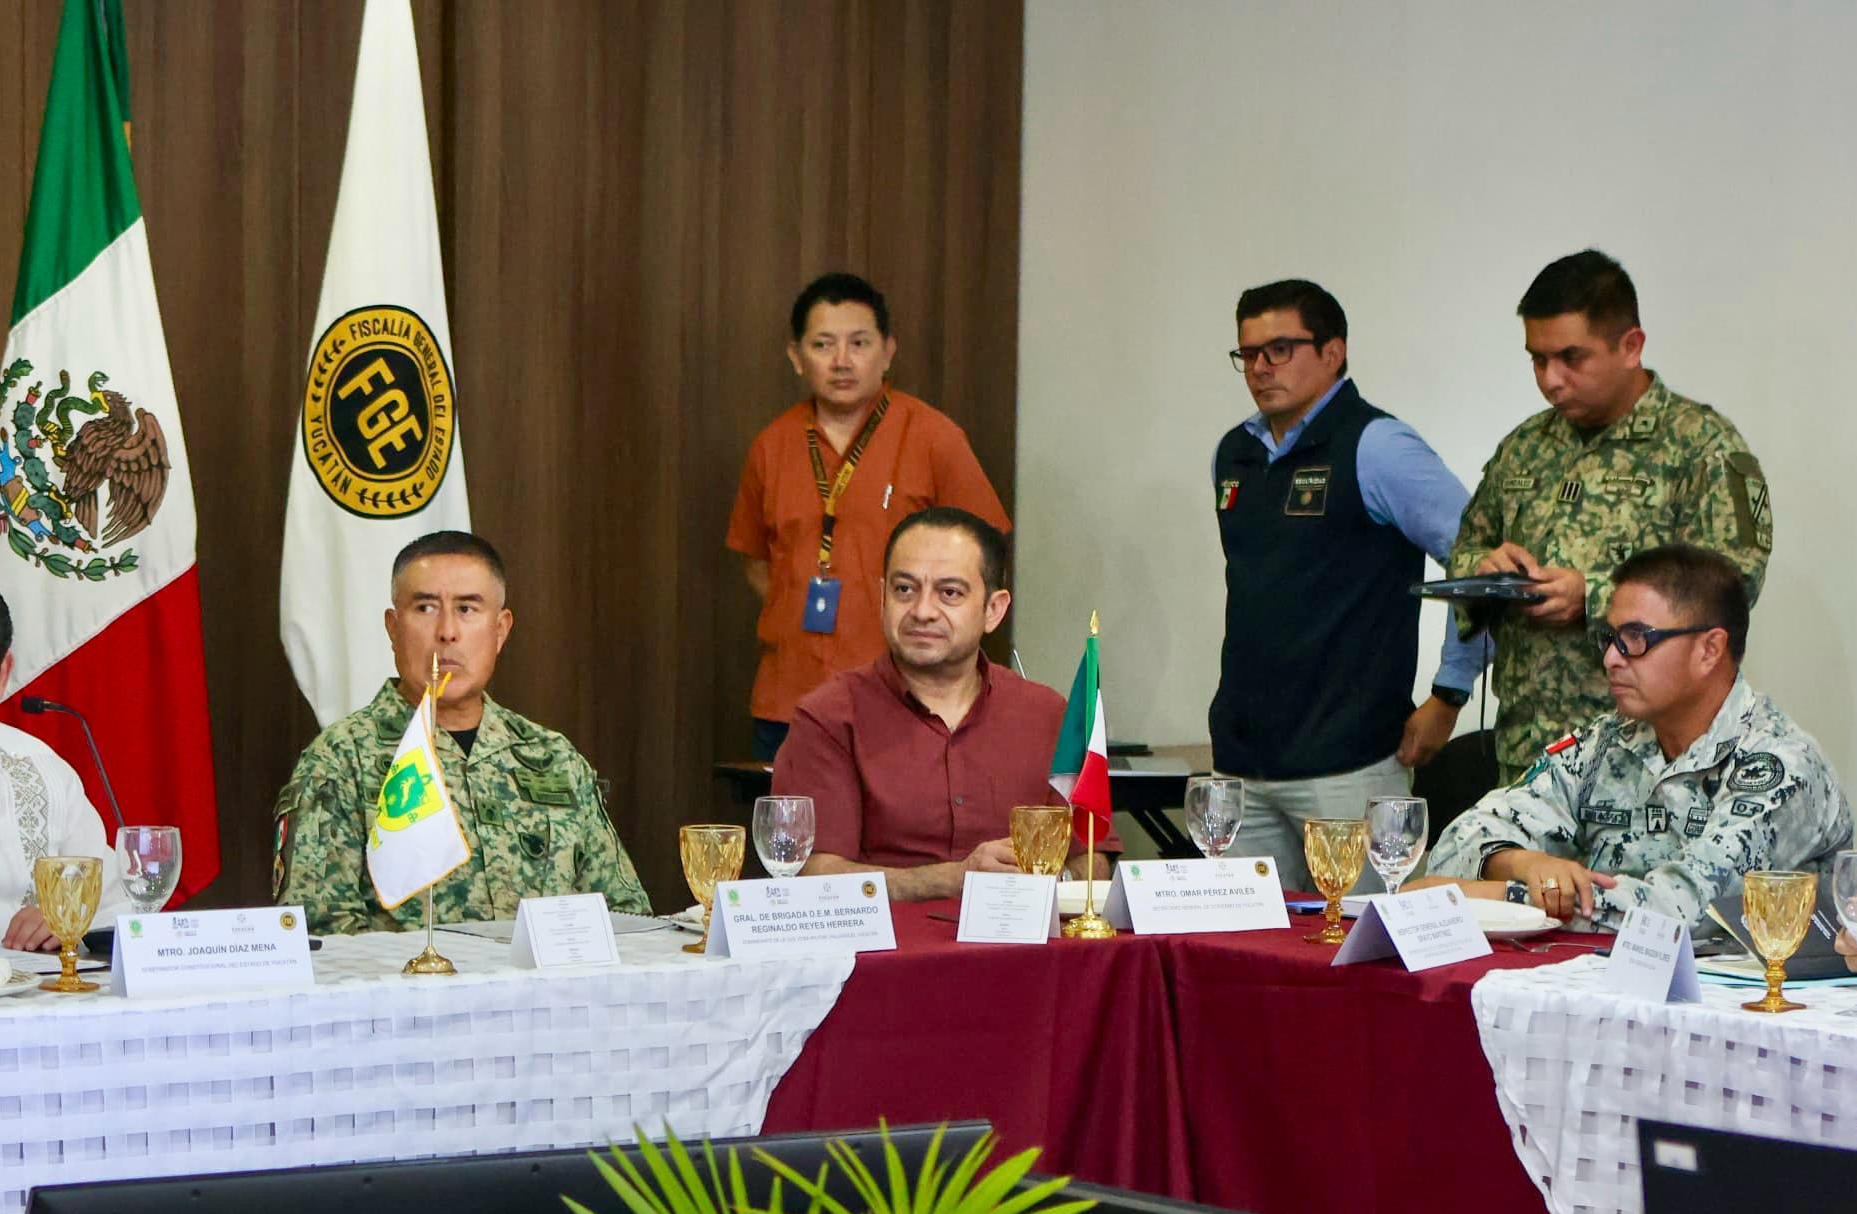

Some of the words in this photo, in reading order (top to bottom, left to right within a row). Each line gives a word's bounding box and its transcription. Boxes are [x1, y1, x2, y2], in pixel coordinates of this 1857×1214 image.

[349, 317, 412, 341] FISCALÍA
[413, 331, 443, 389] GENERAL
[337, 356, 424, 470] FGE
[432, 394, 447, 421] DEL
[310, 415, 352, 496] YUCATÁN
[426, 426, 447, 482] ESTADO
[1180, 888, 1203, 897] OMAR
[733, 914, 757, 923] GRAL.
[759, 913, 770, 921] DE
[771, 910, 808, 920] BRIGADA
[809, 908, 833, 918] D.E.M.
[834, 906, 879, 917] BERNARDO
[751, 923, 798, 934] REGINALDO
[799, 921, 825, 930] REYES
[827, 919, 865, 928] HERRERA
[157, 947, 185, 957] MTRO.
[188, 943, 227, 956] JOAQUÍN
[229, 943, 249, 953] DÍAZ
[251, 942, 277, 952] MENA
